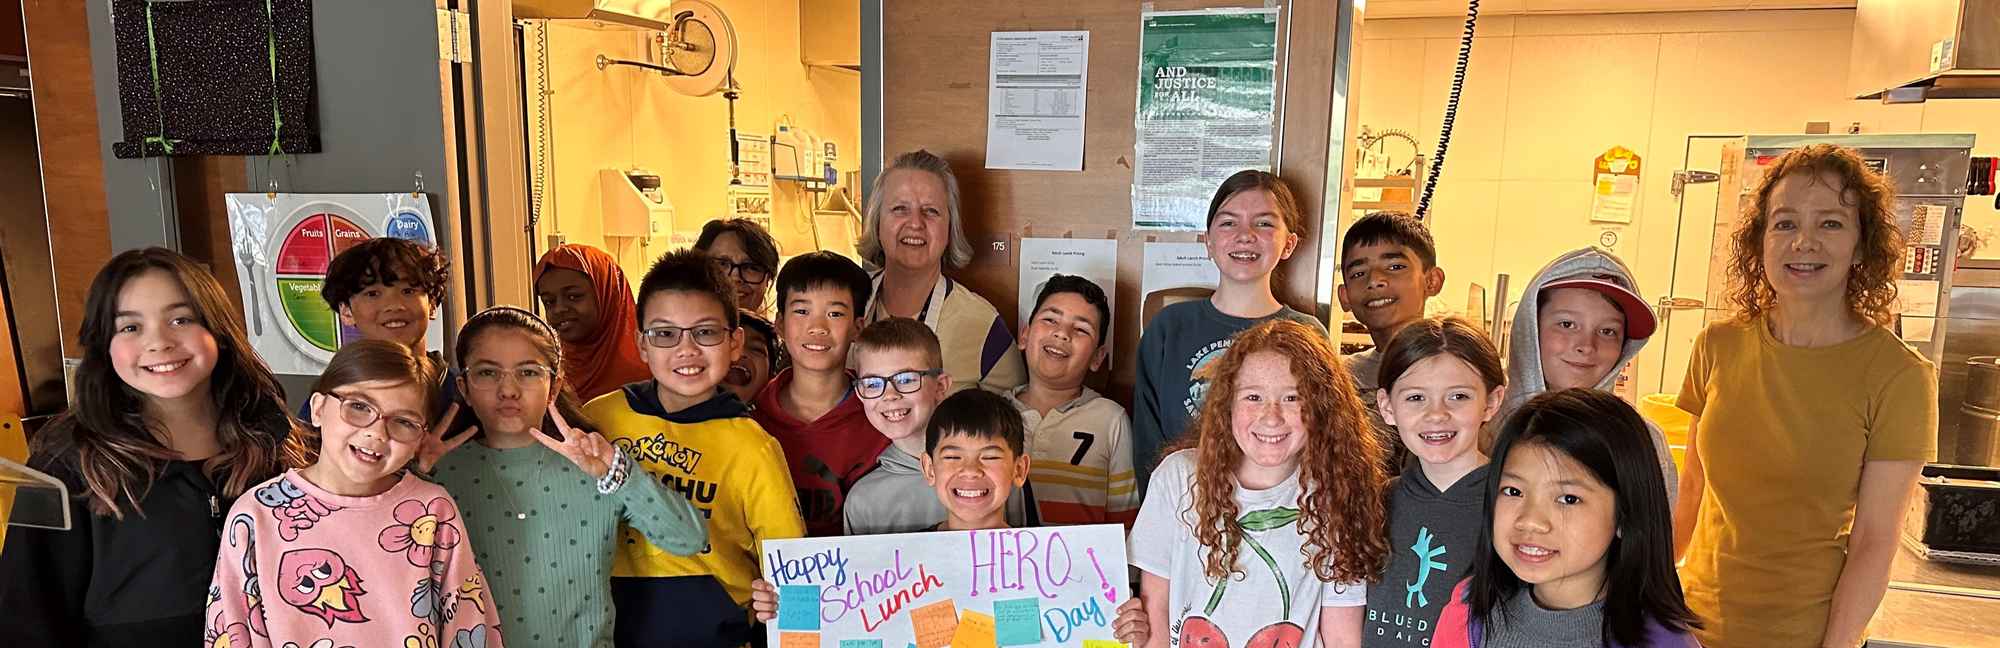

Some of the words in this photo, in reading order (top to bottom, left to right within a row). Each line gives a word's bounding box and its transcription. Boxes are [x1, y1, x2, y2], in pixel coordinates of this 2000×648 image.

[1154, 77, 1217, 89] JUSTICE
[1155, 66, 1187, 78] AND
[302, 228, 324, 238] Fruits
[335, 228, 361, 238] Grains
[396, 219, 419, 231] Dairy
[992, 241, 1005, 251] 175
[1186, 346, 1209, 370] LAKE
[1210, 339, 1234, 351] PEN
[1070, 431, 1095, 466] 7
[768, 547, 849, 588] Happy
[970, 529, 1083, 599] HERO
[821, 549, 913, 624] School
[860, 563, 945, 633] Lunch
[1043, 596, 1107, 643] Day
